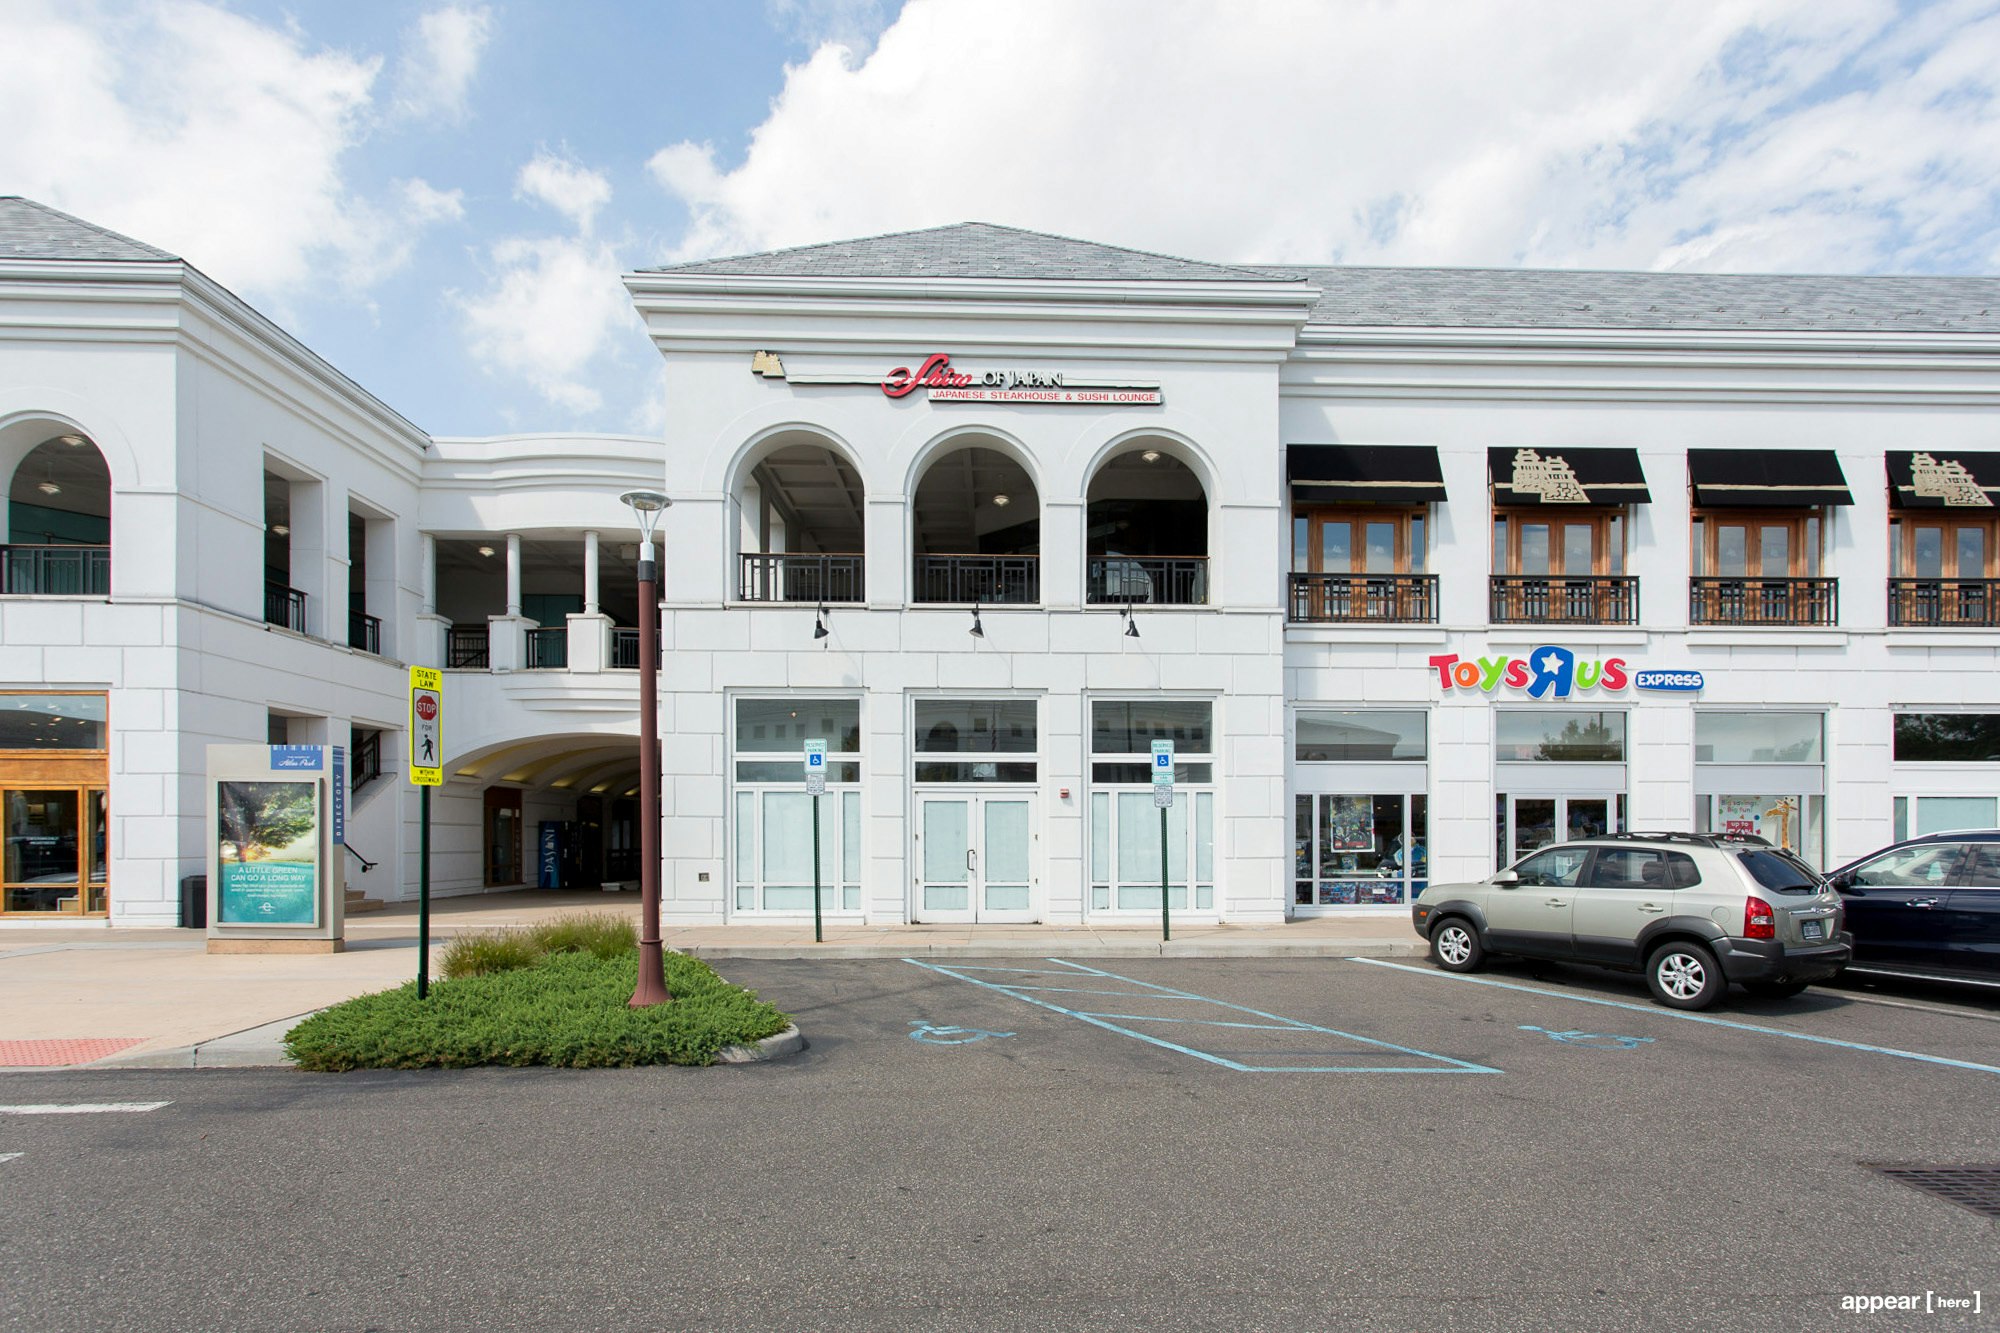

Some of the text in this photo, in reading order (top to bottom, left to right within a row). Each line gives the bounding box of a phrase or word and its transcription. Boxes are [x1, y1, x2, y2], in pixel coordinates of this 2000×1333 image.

[982, 370, 1006, 386] OF
[1009, 371, 1062, 389] JAPAN
[932, 389, 1156, 402] JAPANESE STEAKHOUSE & SUSHI LOUNGE
[416, 669, 437, 681] STATE
[1636, 671, 1702, 688] EXPRESS
[419, 680, 434, 689] LAW
[417, 702, 436, 714] STOP
[421, 724, 433, 732] FOR
[413, 775, 440, 783] CROSSWALK
[238, 866, 298, 874] A LITTLE GREEN
